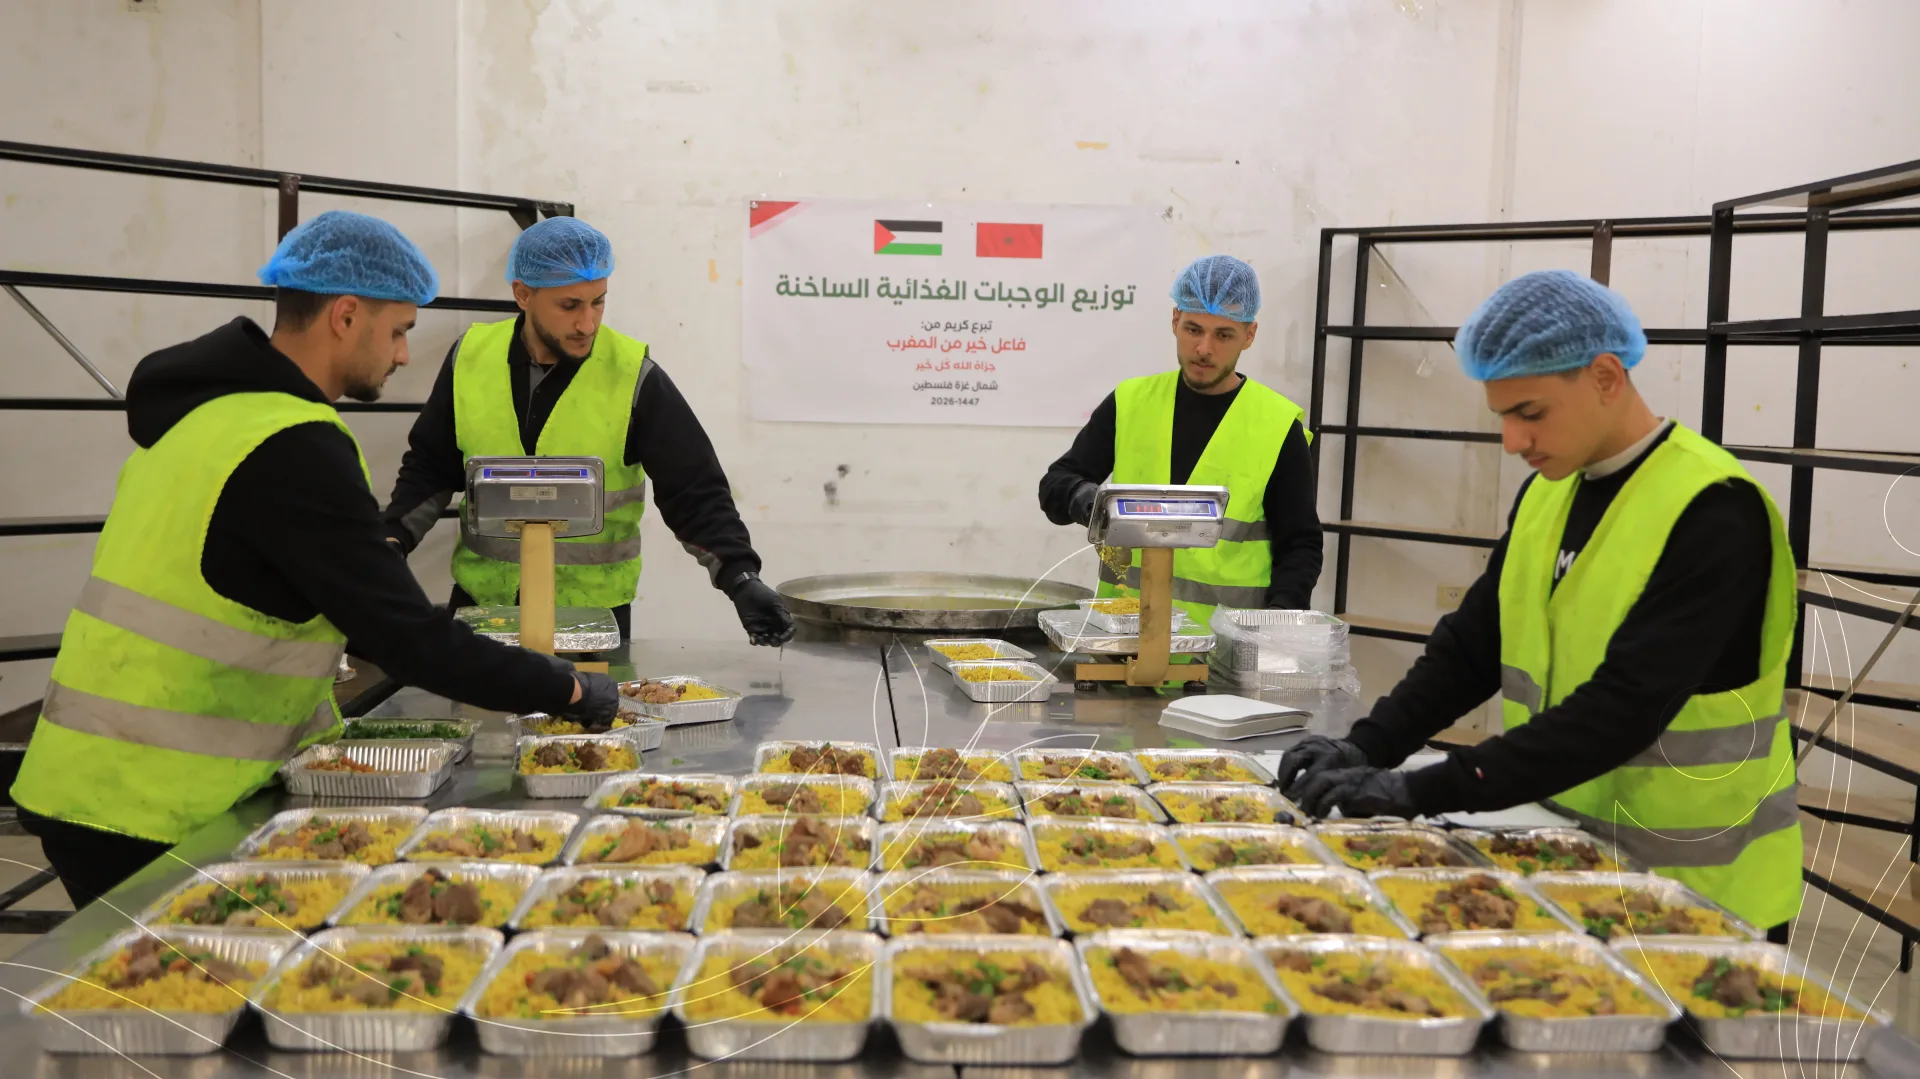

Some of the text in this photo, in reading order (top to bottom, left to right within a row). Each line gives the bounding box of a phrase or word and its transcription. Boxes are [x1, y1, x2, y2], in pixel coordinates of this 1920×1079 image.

[776, 274, 1137, 313] توزيع الوجبات الغذائية الساخنة
[921, 319, 993, 334] تبرع كريم من:
[886, 335, 1026, 354] فاعل خير من المغرب
[953, 360, 972, 371] الله
[912, 380, 998, 392] شمال غزة فلسطين
[931, 397, 980, 406] 2026-1447
